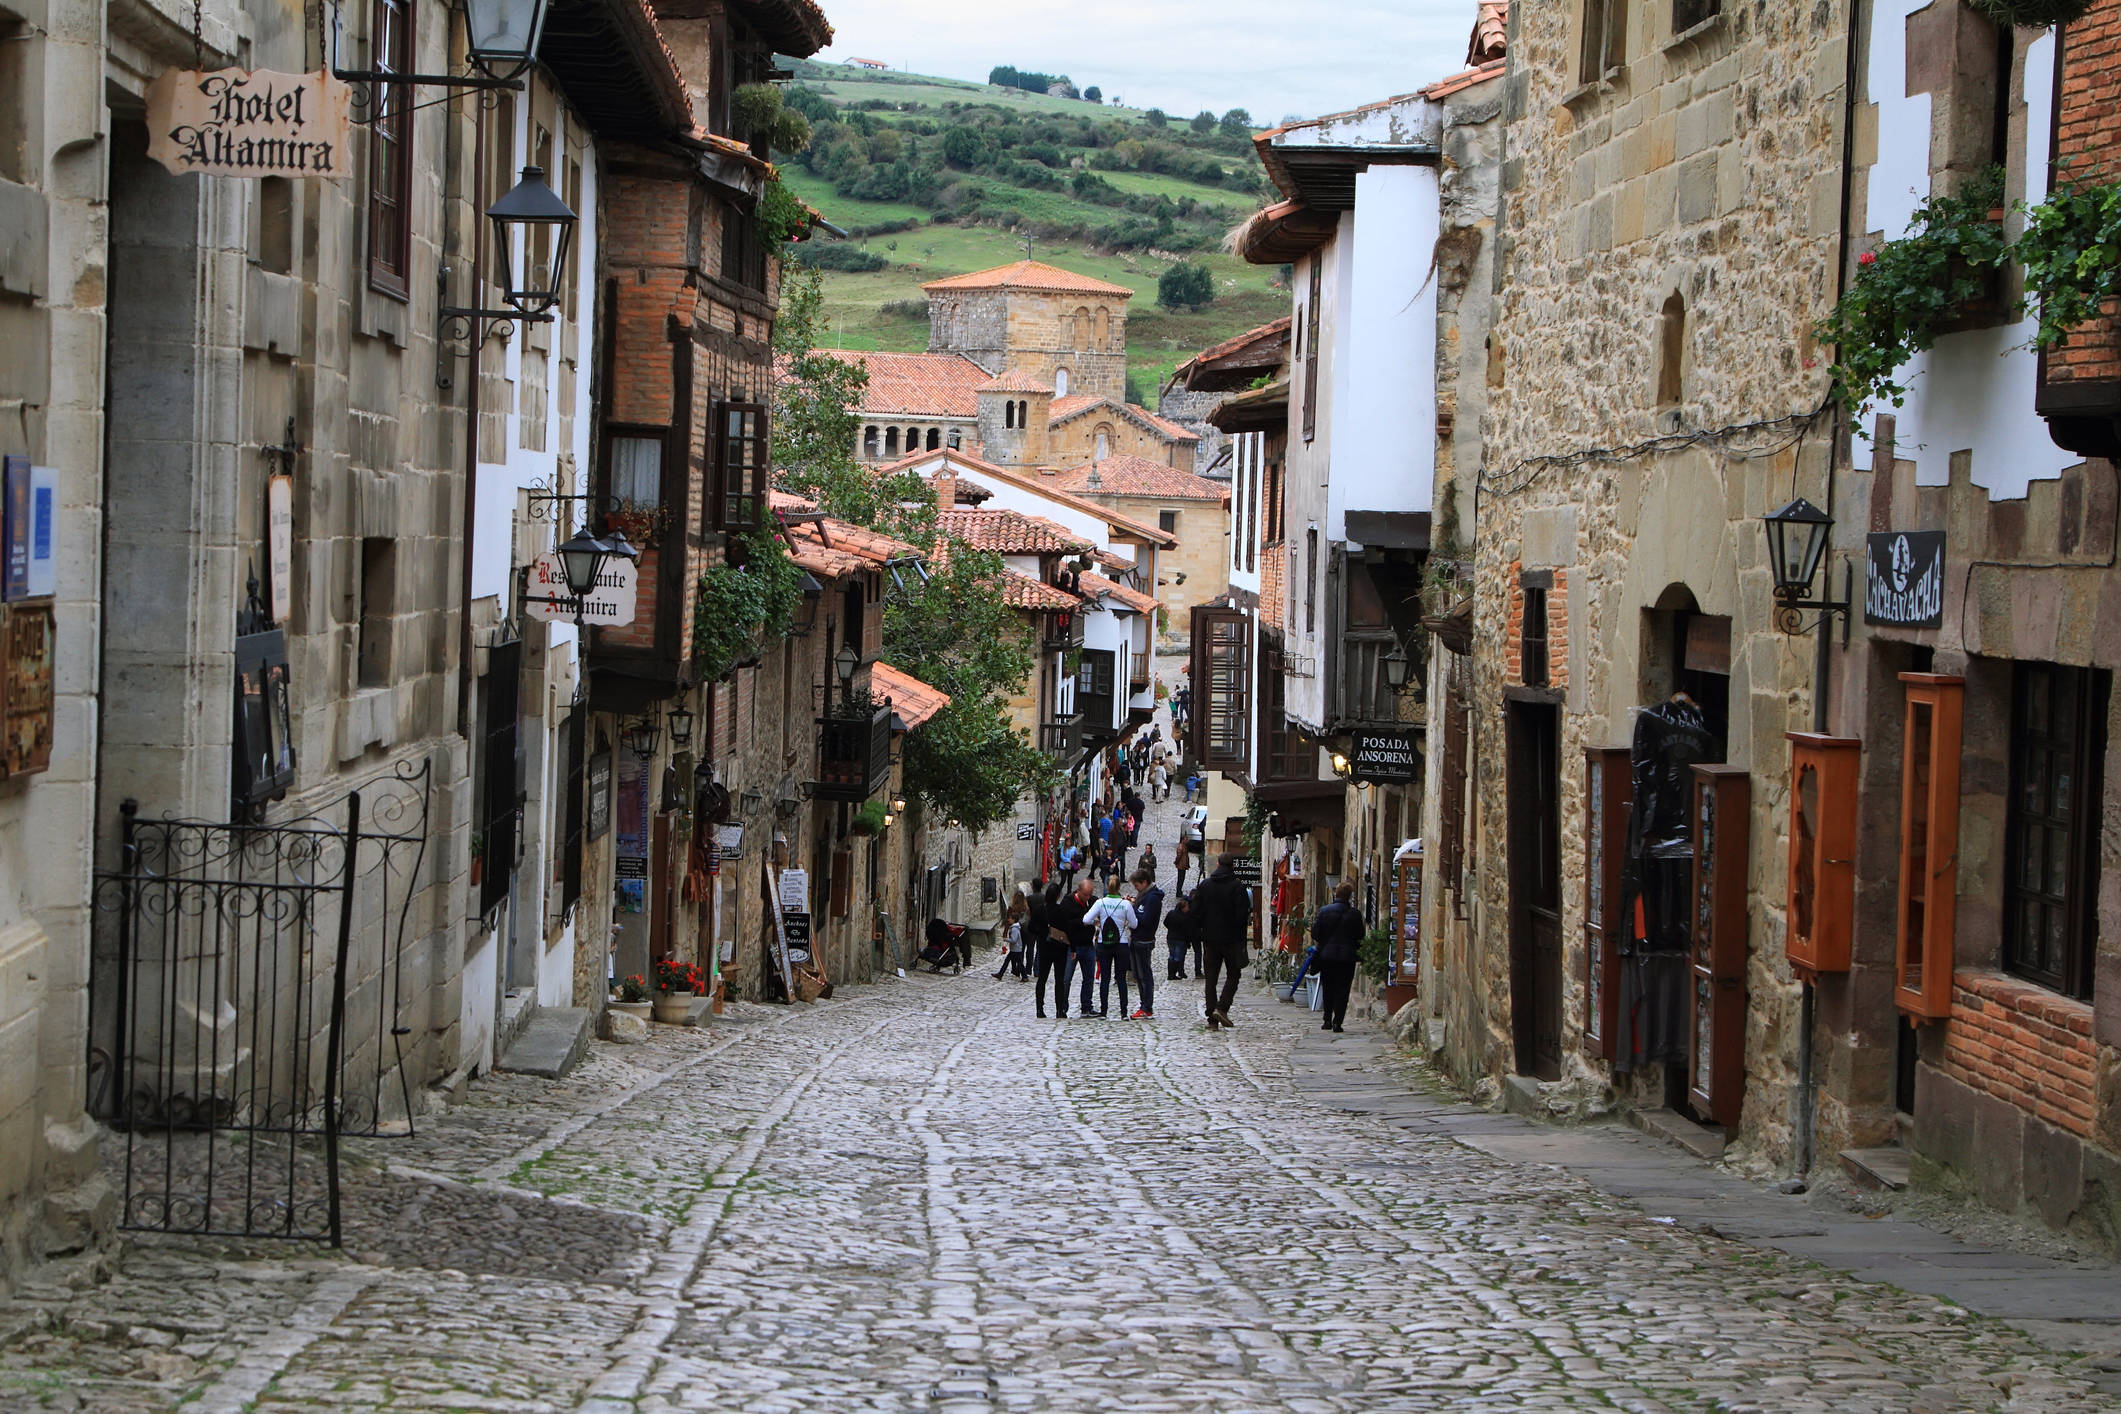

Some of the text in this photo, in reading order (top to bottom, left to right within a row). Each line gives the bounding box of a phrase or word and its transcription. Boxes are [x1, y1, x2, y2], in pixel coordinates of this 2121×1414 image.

[198, 77, 305, 126] Hotel
[168, 121, 333, 172] Altamira
[539, 562, 625, 588] Resante
[1362, 737, 1409, 750] POSADA
[1357, 750, 1413, 764] ANSORENA
